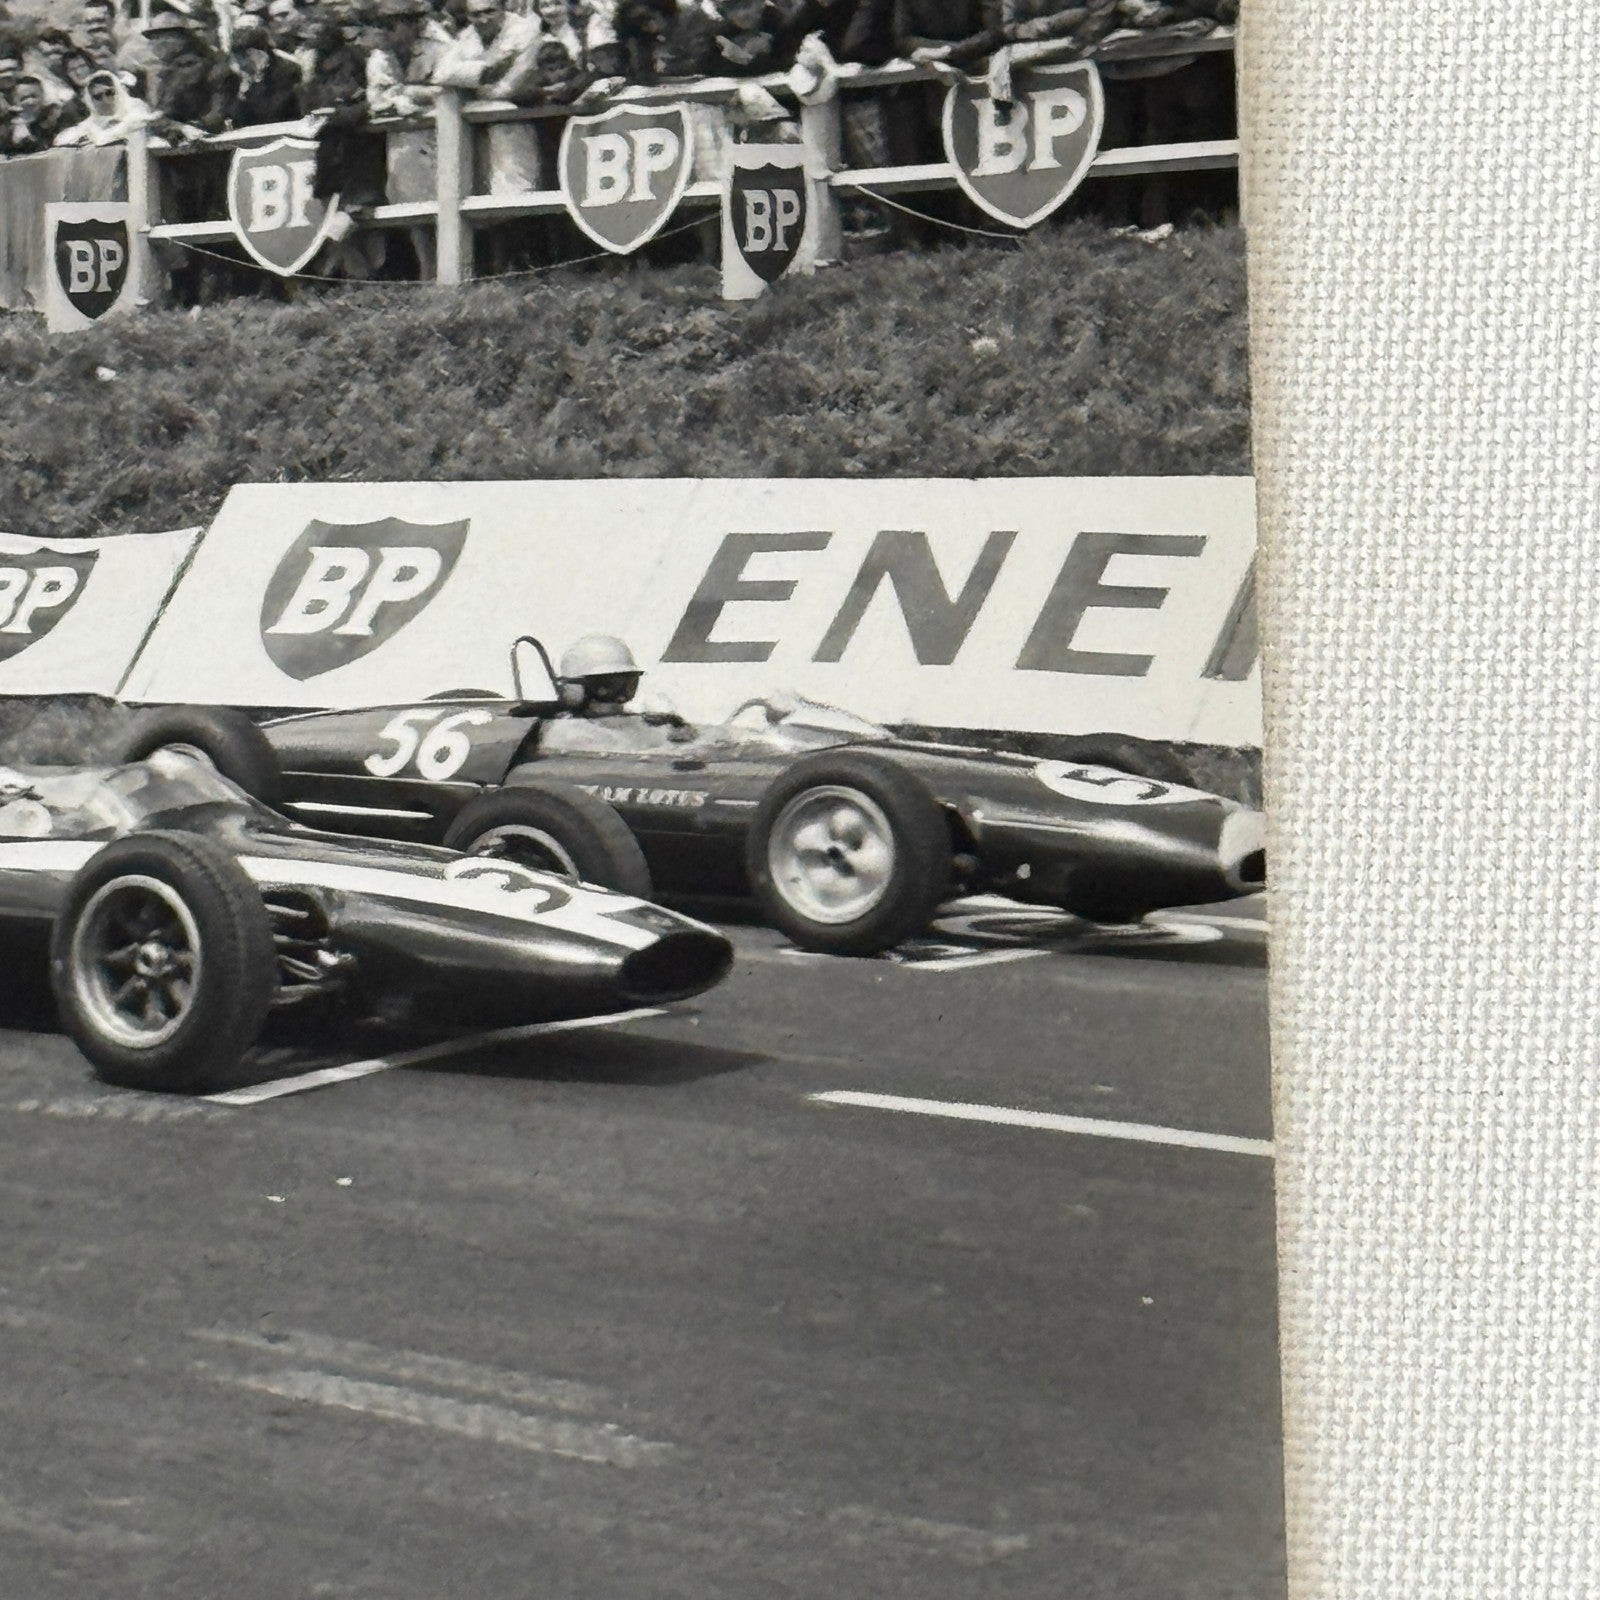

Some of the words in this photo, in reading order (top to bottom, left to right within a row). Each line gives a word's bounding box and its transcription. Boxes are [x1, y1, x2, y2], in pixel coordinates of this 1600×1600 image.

[580, 126, 680, 208] BP
[971, 87, 1087, 177] BP
[743, 189, 799, 253] BP
[65, 239, 123, 293] BP
[265, 546, 442, 636] BP
[364, 708, 493, 781] 56
[454, 867, 573, 914] 3
